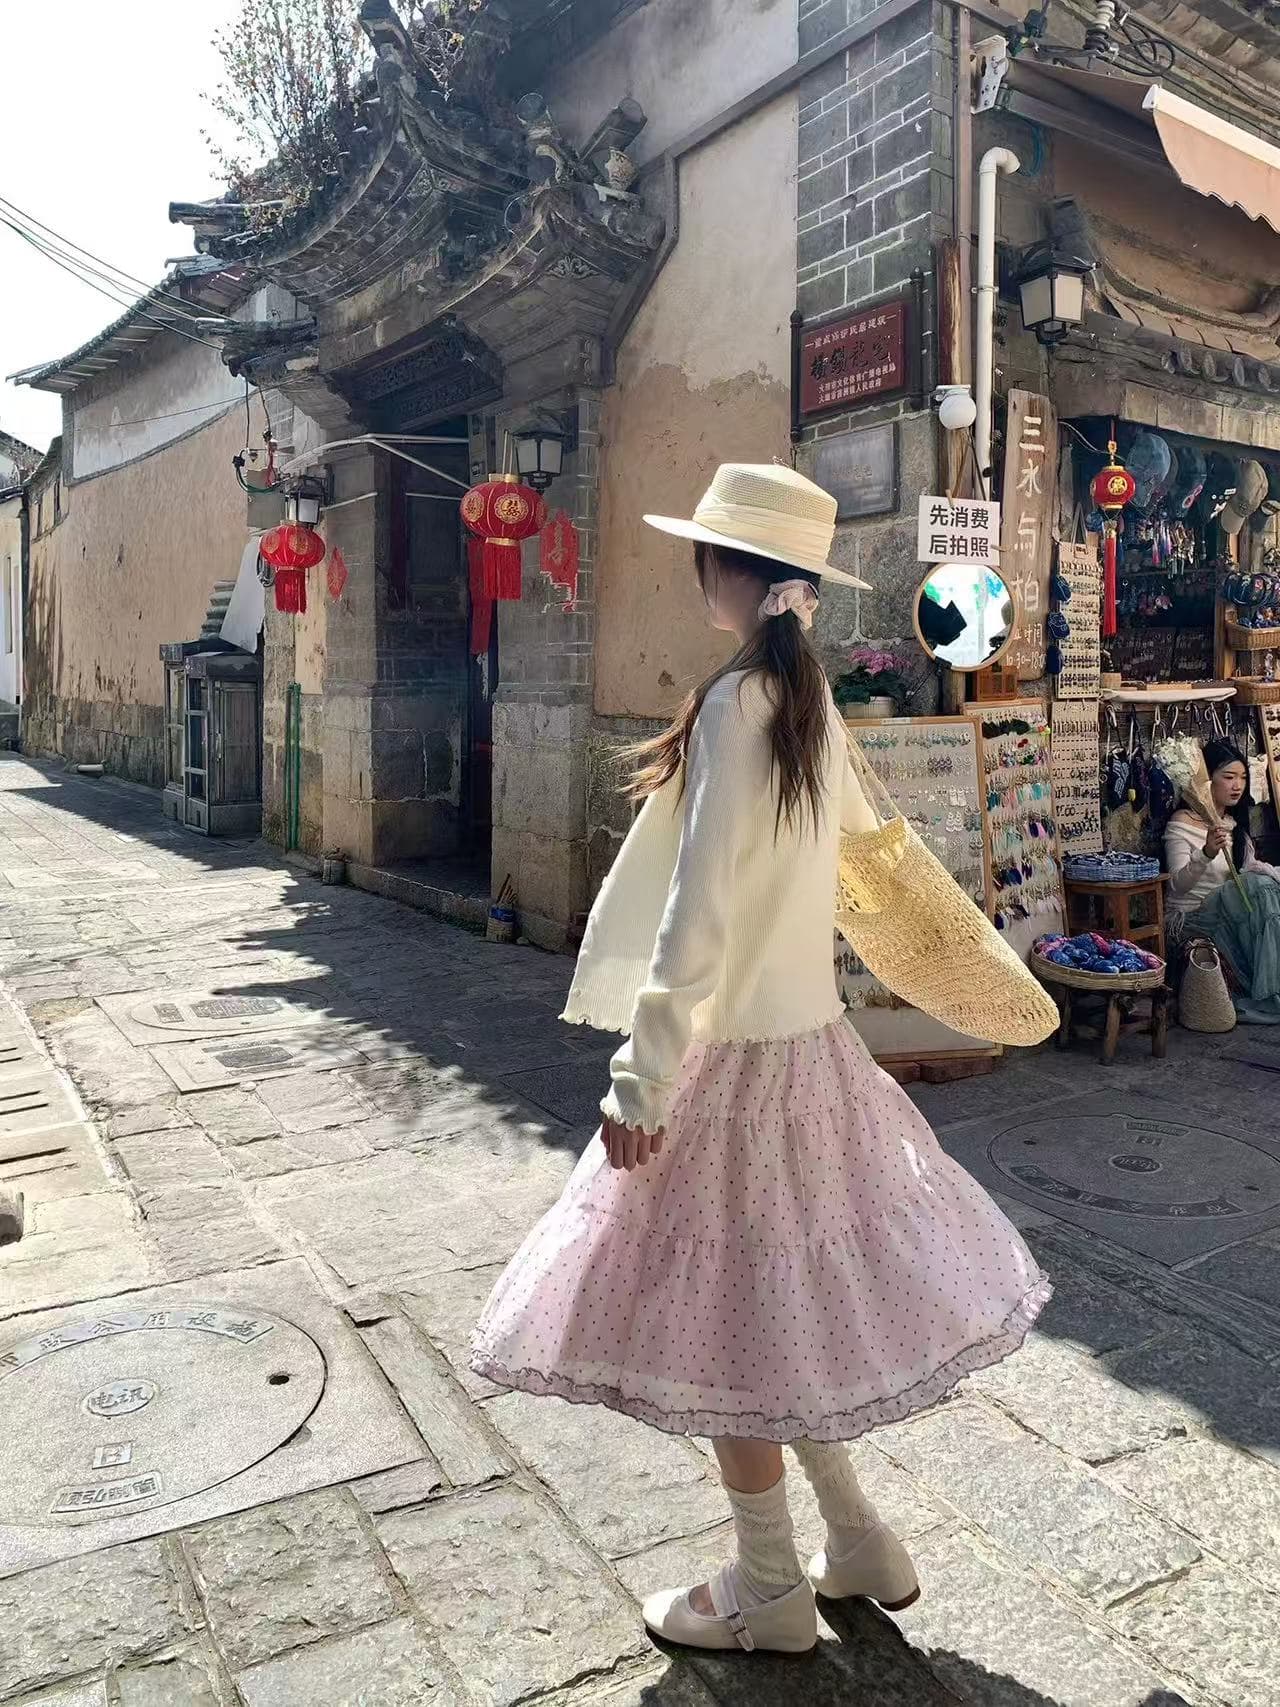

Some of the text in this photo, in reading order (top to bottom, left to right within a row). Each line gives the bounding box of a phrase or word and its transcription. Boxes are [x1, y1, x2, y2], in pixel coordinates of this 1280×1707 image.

[929, 505, 989, 530] 先消费
[1010, 415, 1045, 611] 三水与柏
[929, 534, 990, 558] 后拍照
[90, 1386, 150, 1409] 电讯
